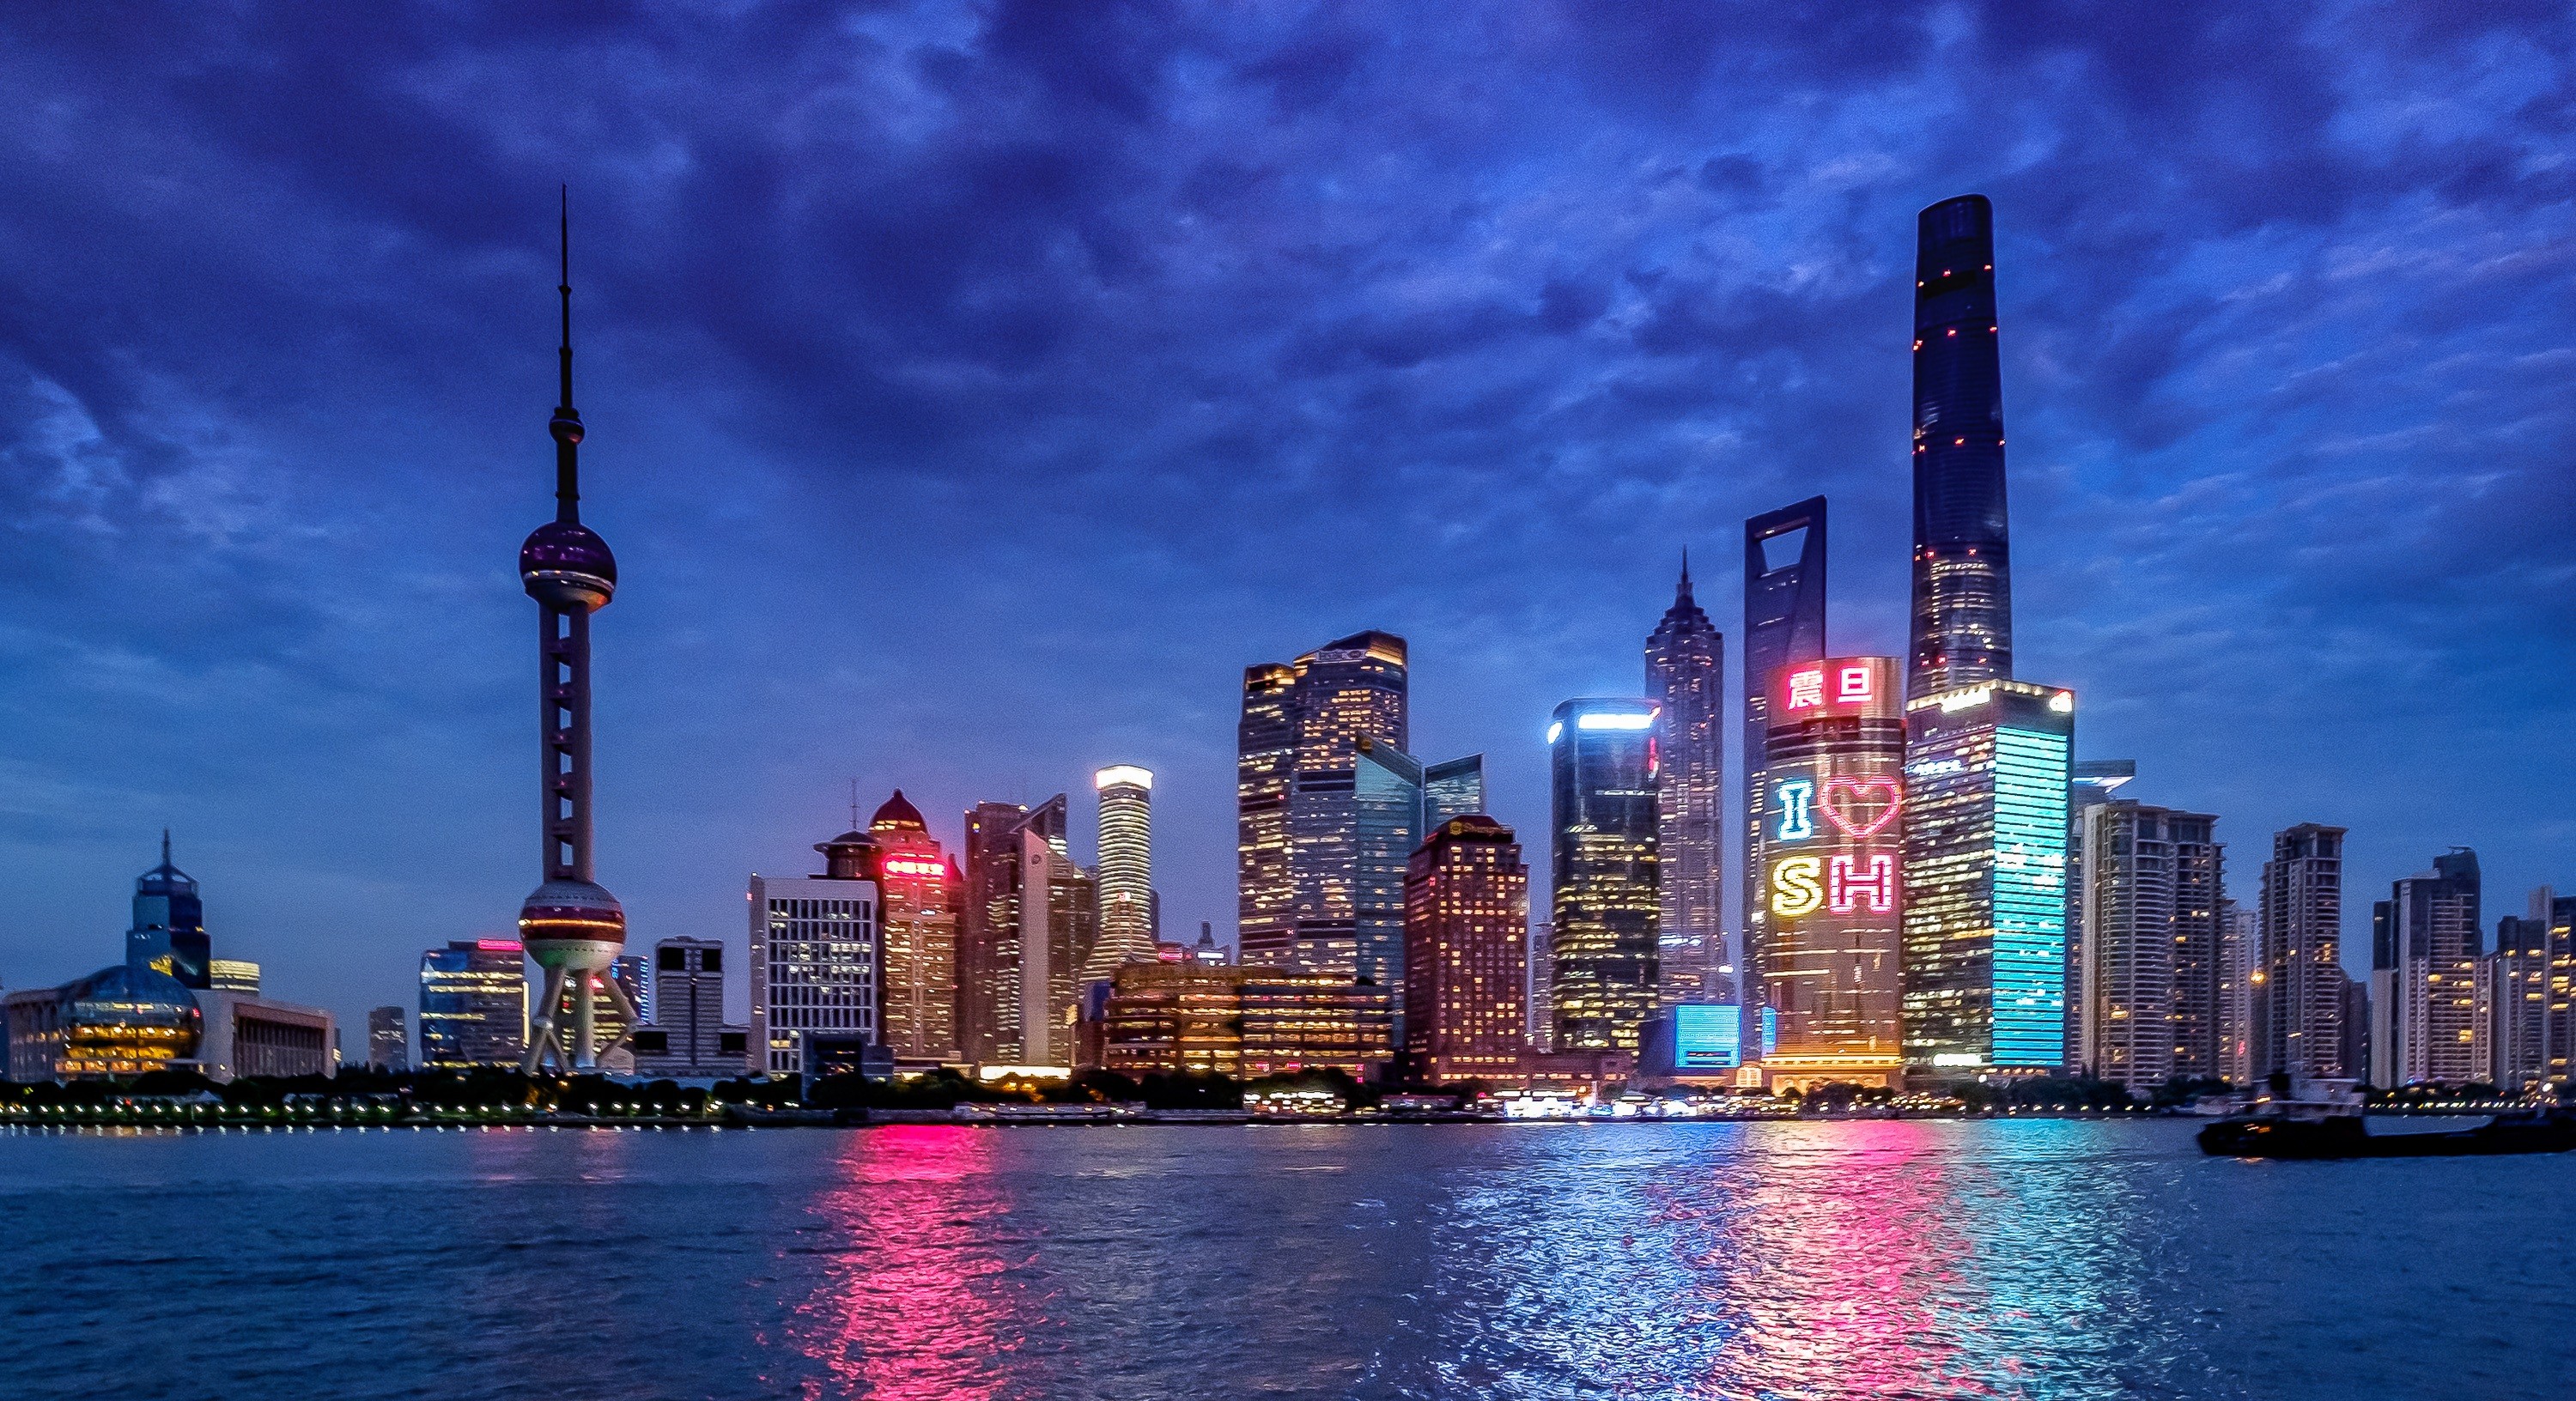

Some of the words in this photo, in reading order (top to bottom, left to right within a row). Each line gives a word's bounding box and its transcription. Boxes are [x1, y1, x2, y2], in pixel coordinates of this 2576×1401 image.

[1788, 667, 1873, 710] 震旦
[1777, 780, 1814, 842] I
[1771, 854, 1894, 917] SH
